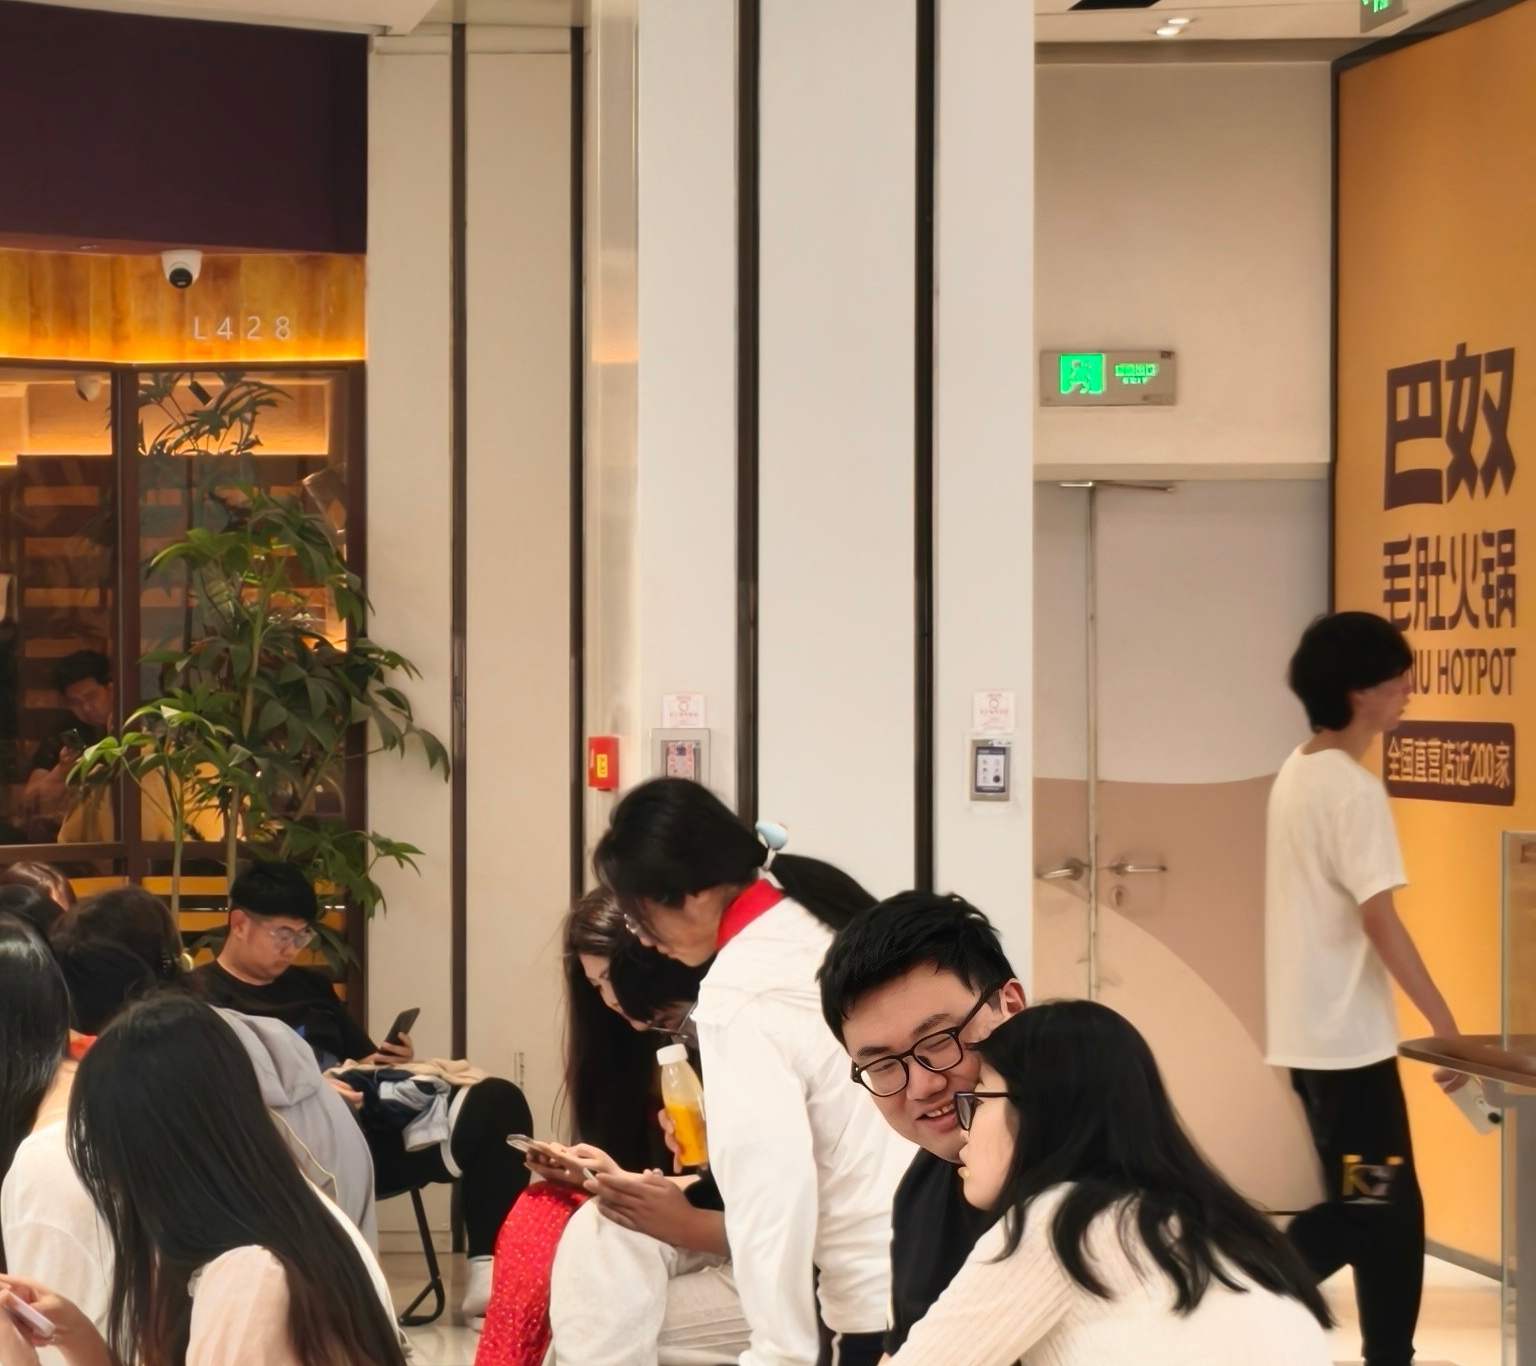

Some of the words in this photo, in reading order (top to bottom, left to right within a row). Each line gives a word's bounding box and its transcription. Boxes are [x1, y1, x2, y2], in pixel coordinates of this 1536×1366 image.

[1383, 342, 1517, 511] 巴奴
[1383, 528, 1516, 632] 毛肚火锅
[1437, 648, 1516, 695] HOTPOT
[1387, 736, 1511, 789] 全国直营店近200家
